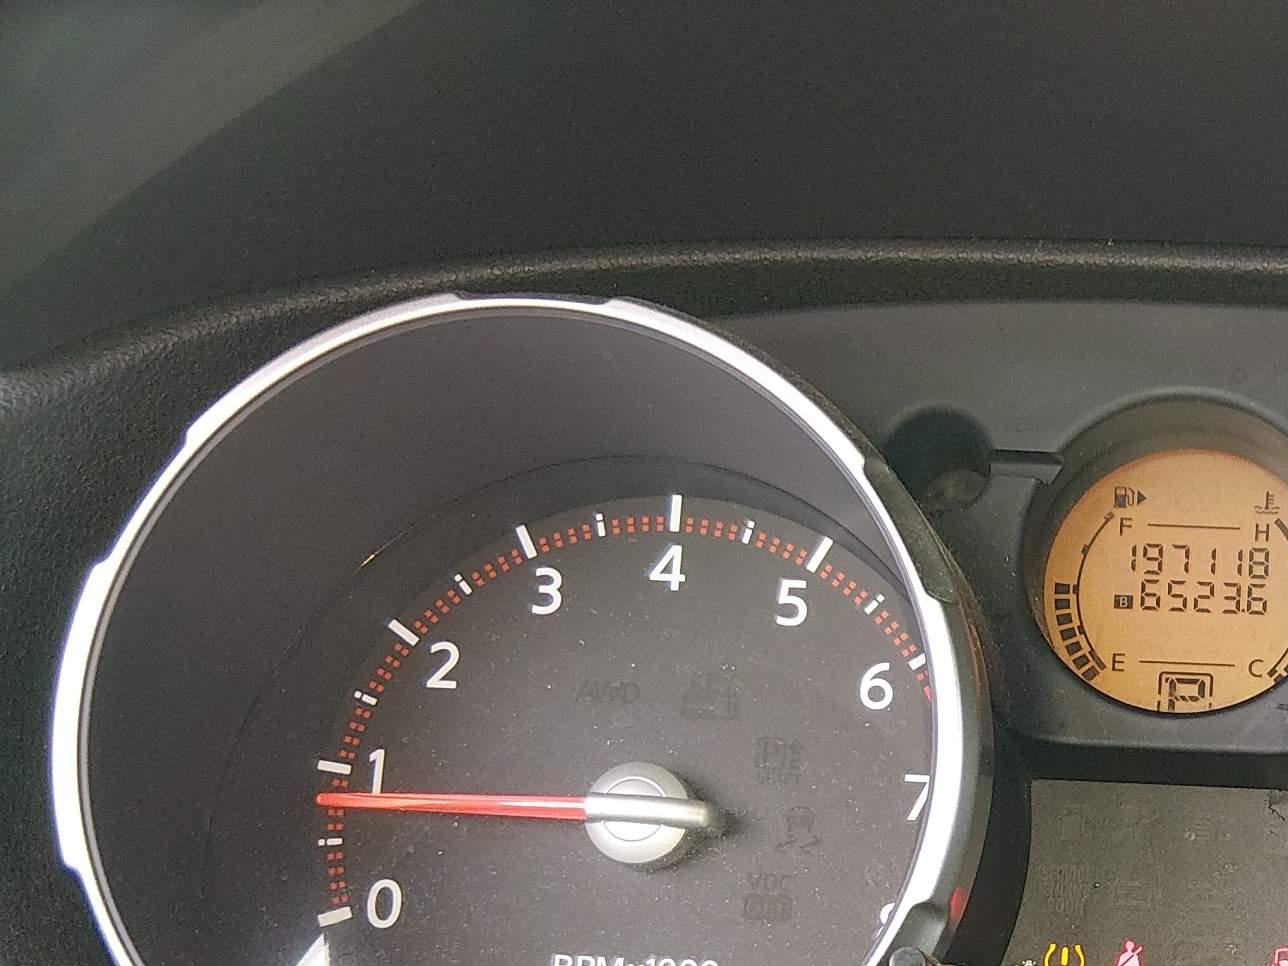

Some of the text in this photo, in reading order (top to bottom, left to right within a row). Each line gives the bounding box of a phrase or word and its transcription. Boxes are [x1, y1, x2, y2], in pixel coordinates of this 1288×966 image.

[1120, 518, 1132, 536] F
[1255, 523, 1269, 541] H
[648, 545, 685, 591] 4
[1131, 543, 1270, 579] 197118
[532, 567, 562, 614] 3
[773, 578, 809, 627] 5
[427, 642, 459, 688] 2
[1112, 653, 1125, 671] E
[1249, 659, 1263, 677] C
[859, 662, 893, 711] 6
[1167, 677, 1206, 711] P
[369, 748, 385, 794] 1
[904, 774, 930, 821] 7
[367, 879, 401, 928] 0
